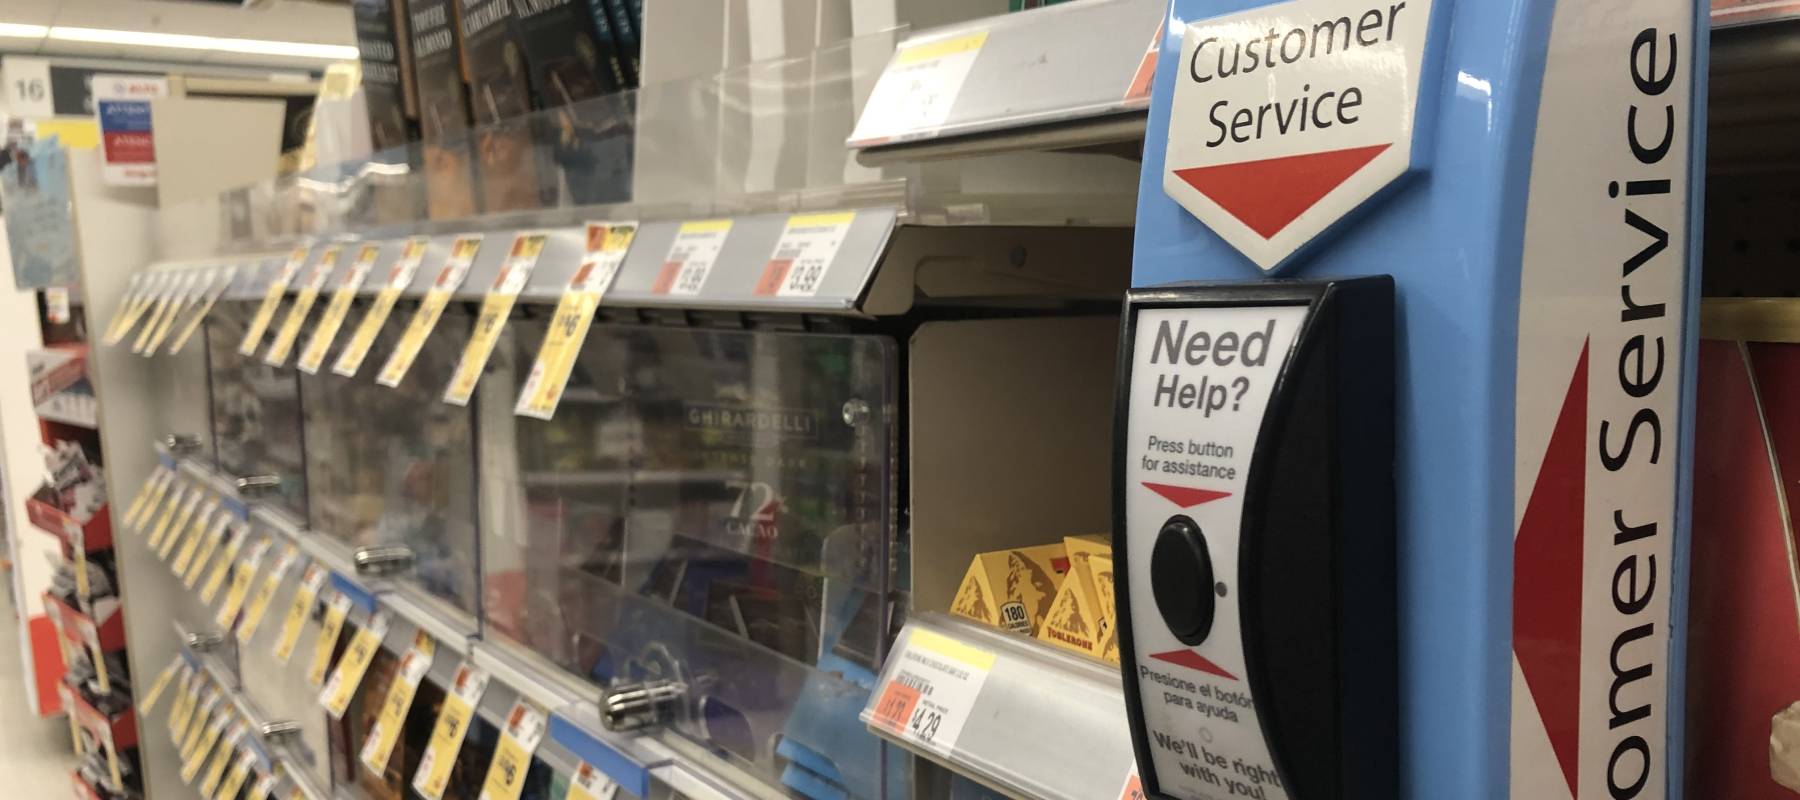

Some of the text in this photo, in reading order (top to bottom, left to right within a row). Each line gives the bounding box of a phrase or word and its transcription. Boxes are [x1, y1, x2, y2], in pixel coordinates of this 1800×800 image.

[1190, 2, 1406, 83] Customer
[16, 79, 45, 102] 16
[1206, 84, 1363, 148] Service
[1599, 27, 1678, 472] Service
[1150, 319, 1276, 367] Need
[1153, 374, 1250, 418] Help?
[688, 408, 811, 433] GHIRARDELLI
[1148, 435, 1233, 458] Press button
[1141, 455, 1236, 480] for assistance
[726, 521, 779, 539] CACAO
[1004, 605, 1025, 621] 180
[1047, 625, 1093, 651] TOBLERONE
[1140, 665, 1196, 694] Presione
[1200, 683, 1211, 698] el
[1163, 691, 1239, 723] para ayuda
[1152, 730, 1281, 788] We'll be right
[1180, 761, 1221, 786] with
